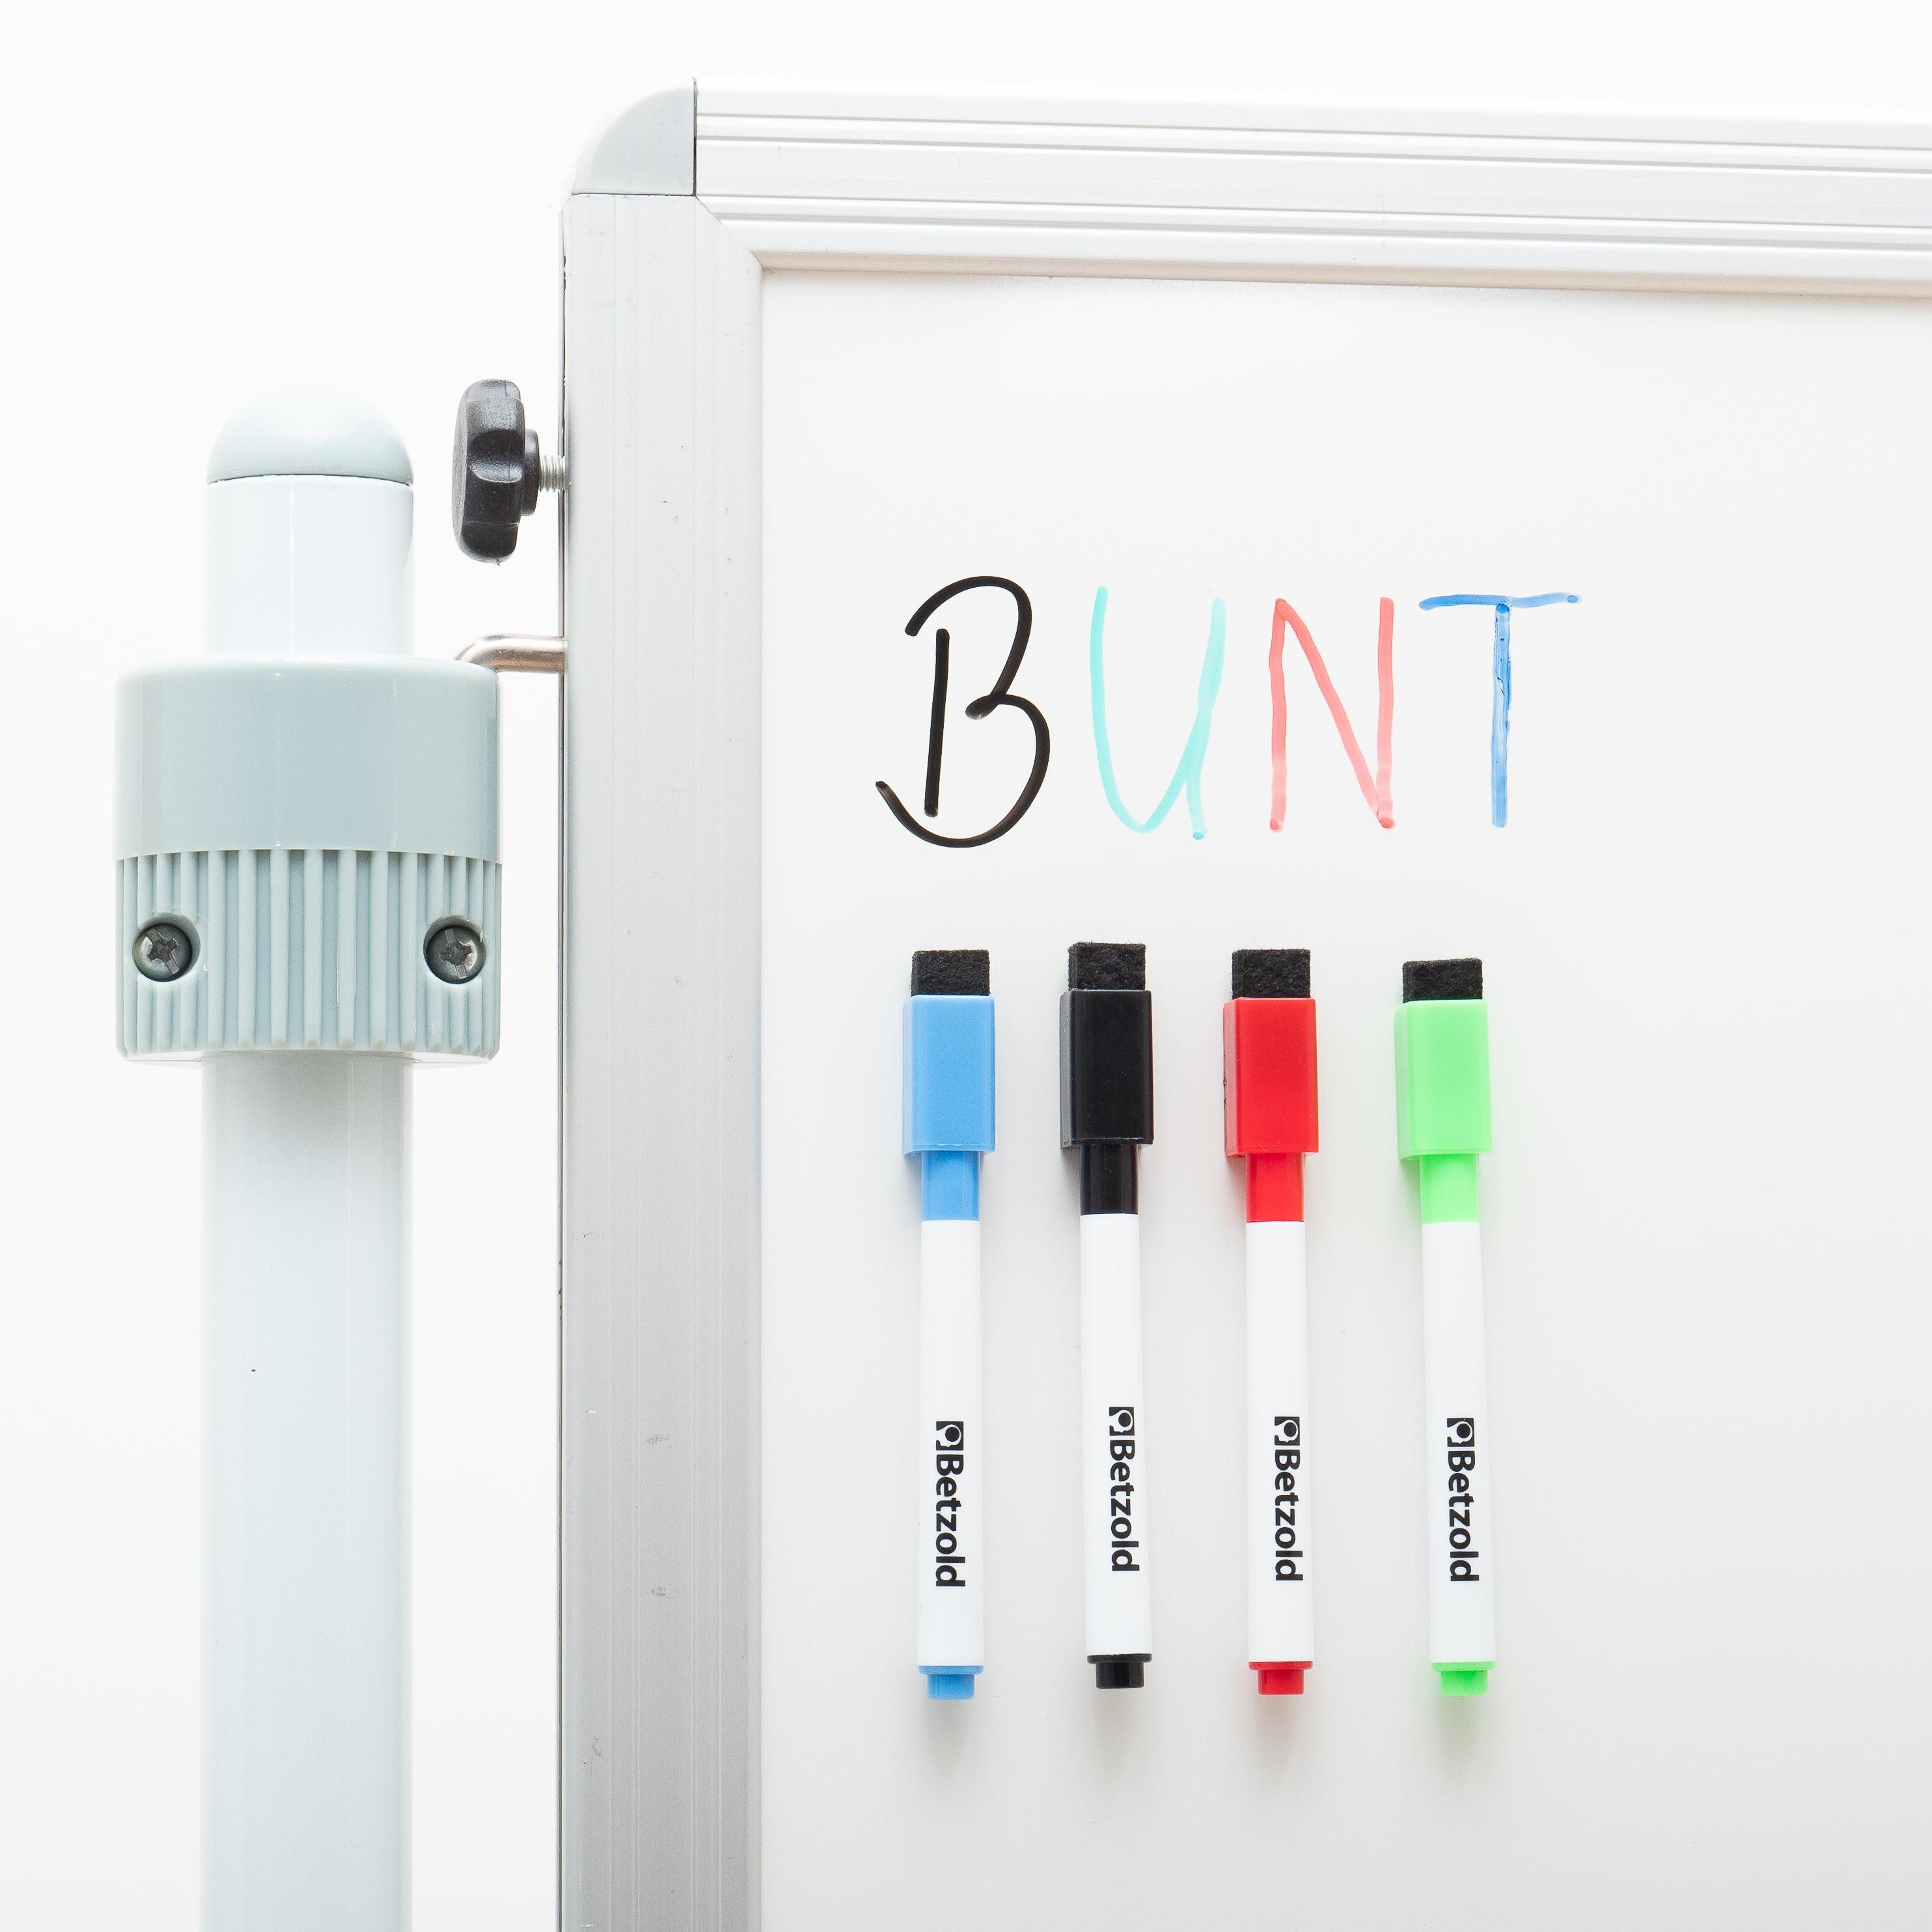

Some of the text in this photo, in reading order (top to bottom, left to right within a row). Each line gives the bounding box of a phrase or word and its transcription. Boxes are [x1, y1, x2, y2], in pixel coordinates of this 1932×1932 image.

[875, 575, 1582, 849] BUNT
[935, 1454, 966, 1587] Betzold
[1109, 1439, 1140, 1571] Betzold
[1275, 1449, 1304, 1581] Betzold
[1448, 1450, 1480, 1582] Betzold
